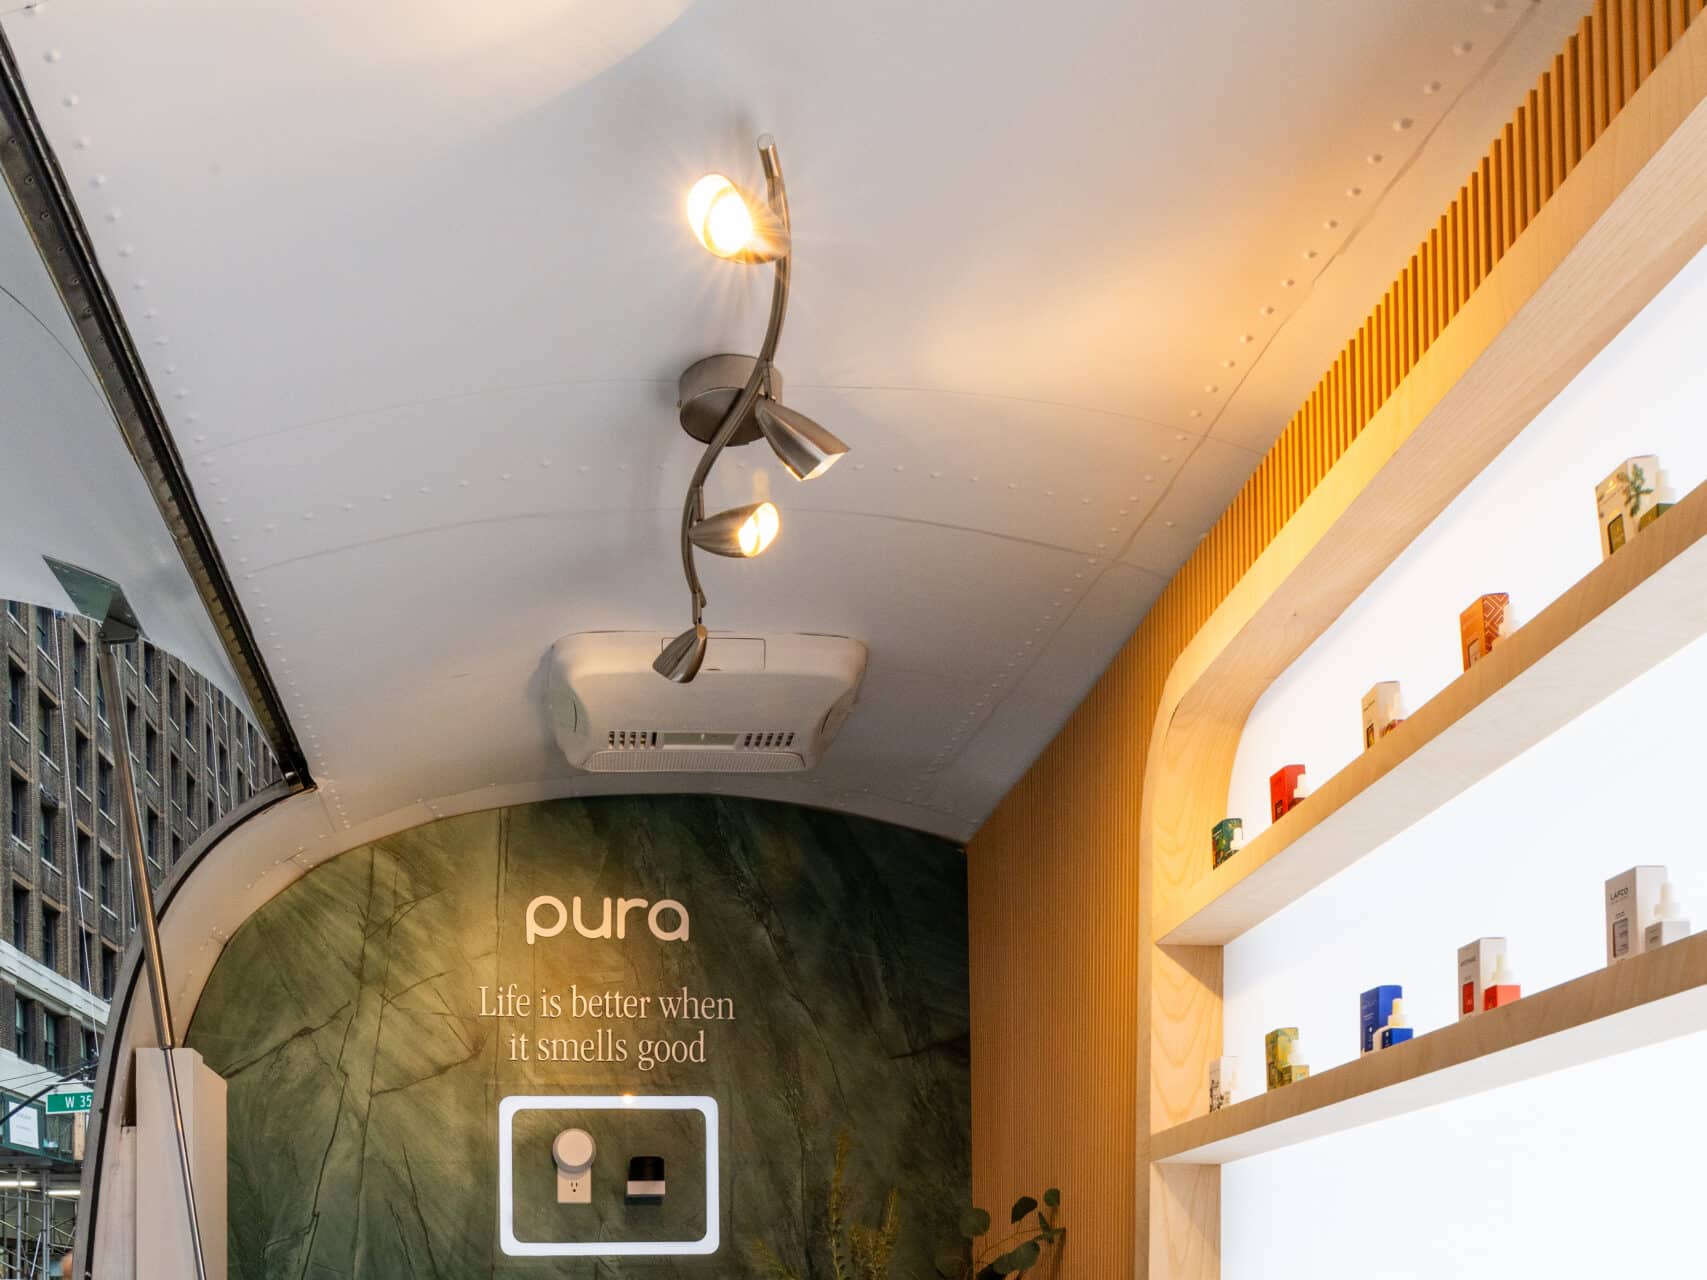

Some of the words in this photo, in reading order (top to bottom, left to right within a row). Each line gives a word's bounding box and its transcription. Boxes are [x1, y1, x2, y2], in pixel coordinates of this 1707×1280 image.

[525, 895, 690, 945] pura
[479, 983, 531, 1018] Life
[541, 988, 562, 1018] is
[571, 984, 651, 1019] better
[658, 986, 737, 1020] when
[509, 1032, 529, 1061] it
[538, 1029, 628, 1062] smells
[638, 1030, 707, 1071] good
[64, 1095, 75, 1109] W
[80, 1095, 92, 1108] 35
